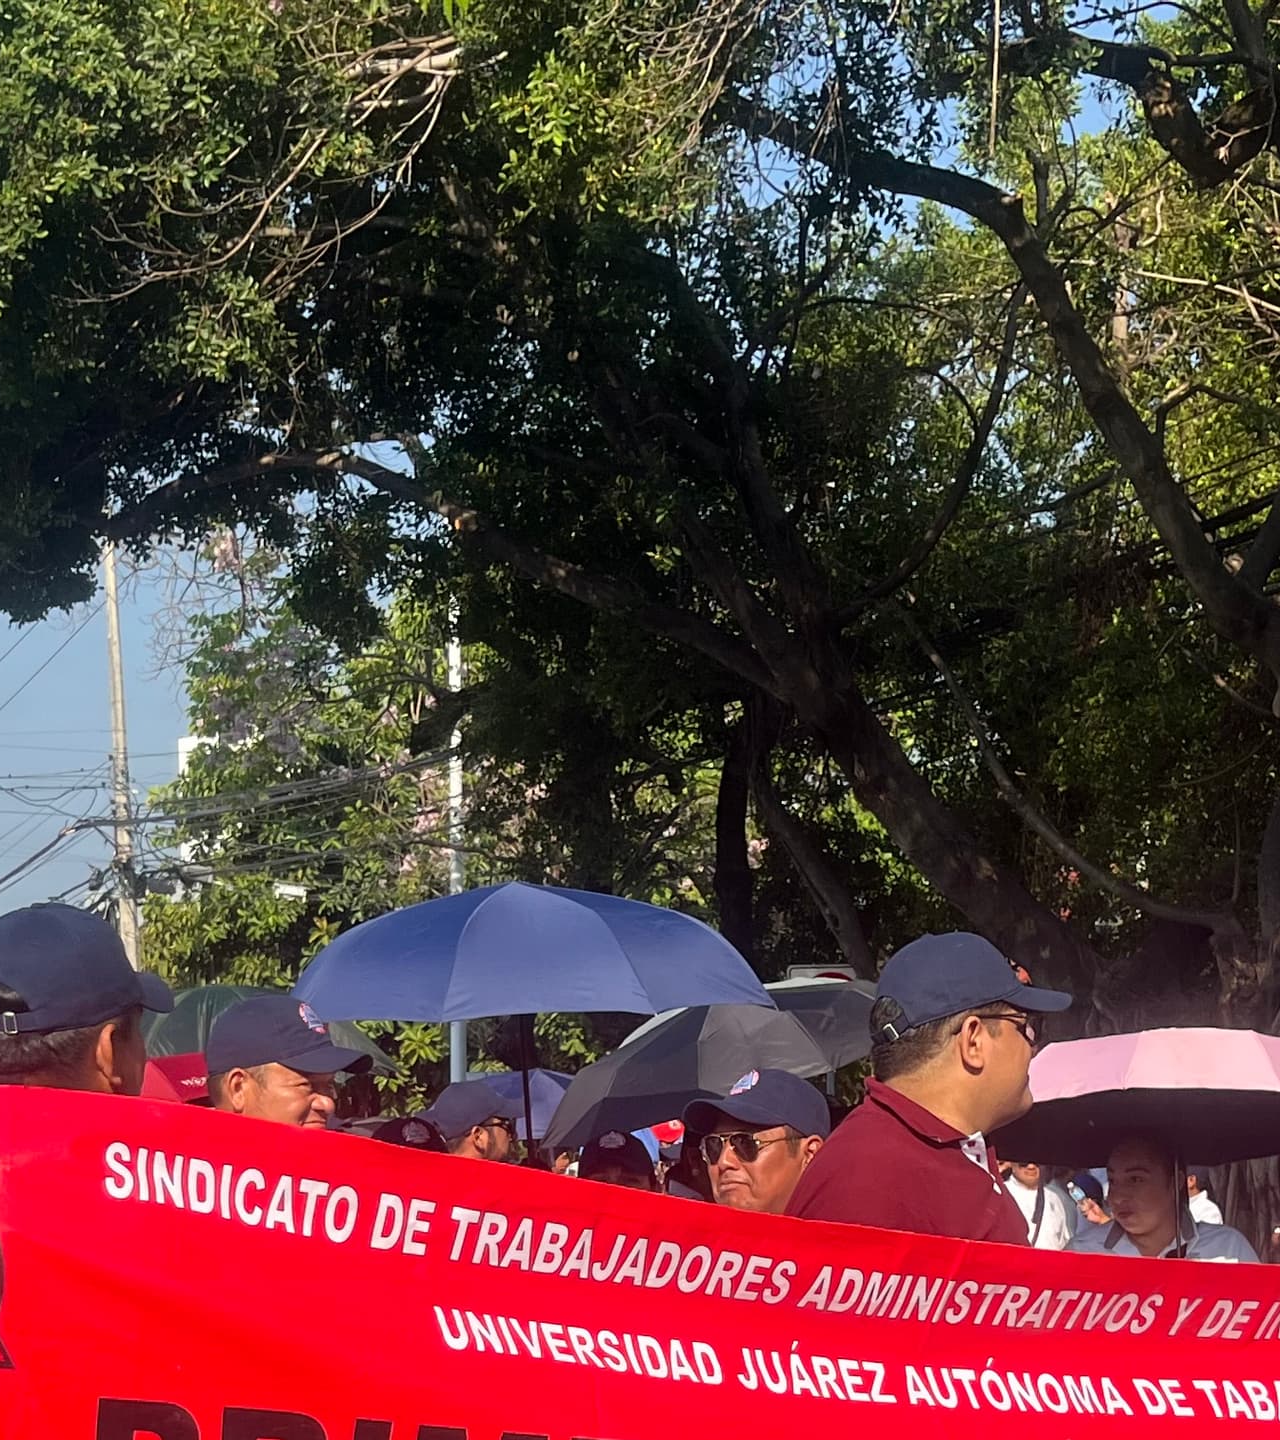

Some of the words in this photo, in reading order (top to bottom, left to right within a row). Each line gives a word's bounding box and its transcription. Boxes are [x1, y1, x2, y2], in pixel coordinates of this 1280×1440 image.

[104, 1142, 359, 1244] SINDICATO
[370, 1193, 436, 1256] DE
[449, 1206, 797, 1305] TRABAJADORES
[798, 1266, 1165, 1335] ADMINISTRATIVOS
[1168, 1297, 1203, 1337] Y
[1197, 1300, 1260, 1340] DE
[433, 1304, 723, 1385] UNIVERSIDAD
[737, 1340, 898, 1405] JUÁREZ
[906, 1357, 1134, 1417] AUTÓNOMA
[1132, 1377, 1195, 1418] DE
